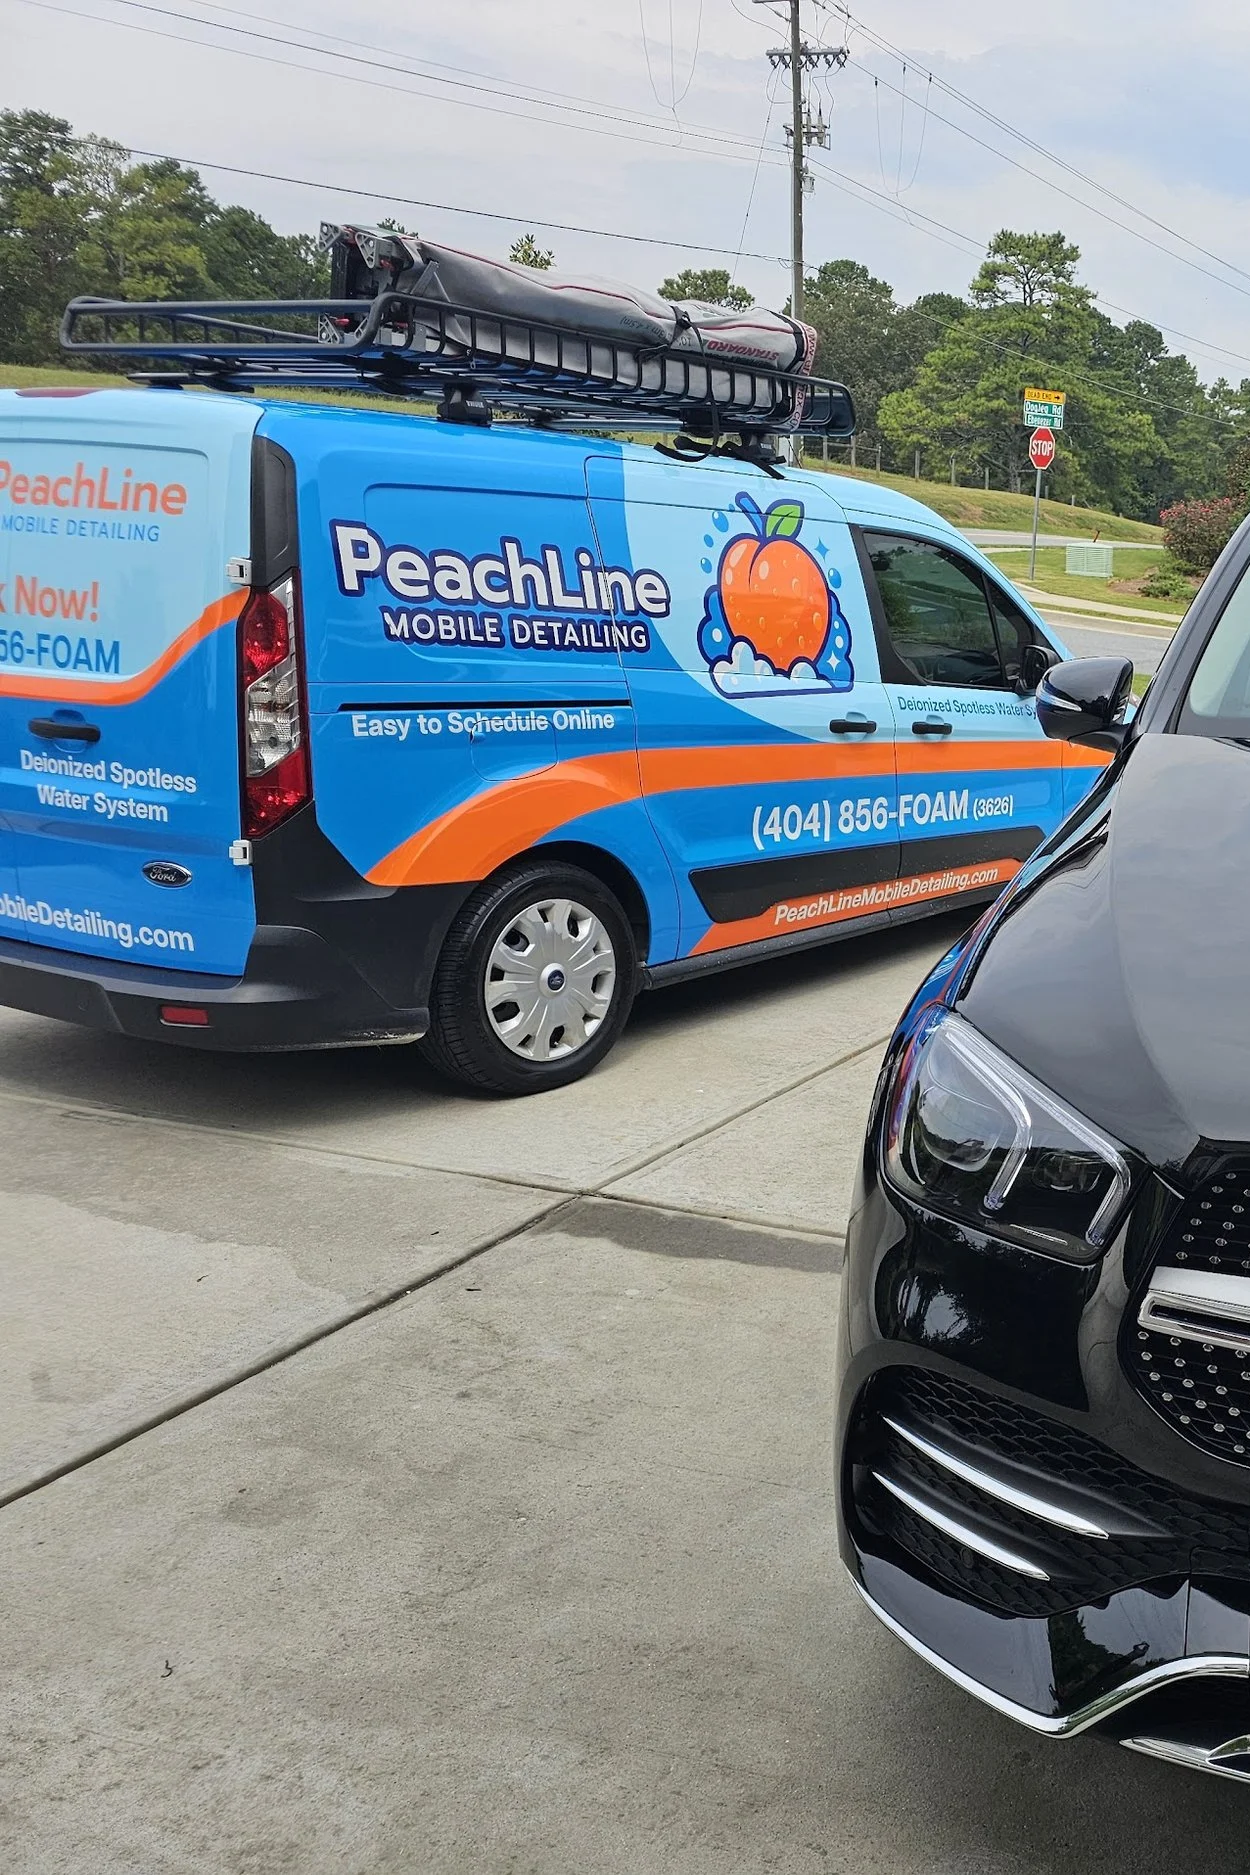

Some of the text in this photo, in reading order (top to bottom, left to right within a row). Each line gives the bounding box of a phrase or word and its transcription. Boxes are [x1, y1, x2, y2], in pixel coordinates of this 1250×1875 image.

[707, 339, 780, 361] STANDARD
[1053, 404, 1062, 415] Rd
[1031, 439, 1053, 456] STOP
[2, 514, 160, 542] MOBILE DETAILING
[334, 524, 668, 614] PeachLine
[15, 574, 99, 622] Now!
[383, 612, 648, 648] MOBILE DETAILING
[897, 696, 951, 712] Deionized
[953, 701, 996, 717] Spotless
[995, 702, 1023, 716] Water
[352, 709, 616, 741] Easy to Schedule Online
[20, 750, 197, 793] Deionized Spotless
[37, 783, 169, 822] Water System
[752, 789, 1014, 850] (404) 856-FOAM (3626)
[149, 866, 177, 883] Ford
[774, 865, 999, 925] PeachLineMobileDetailing.com
